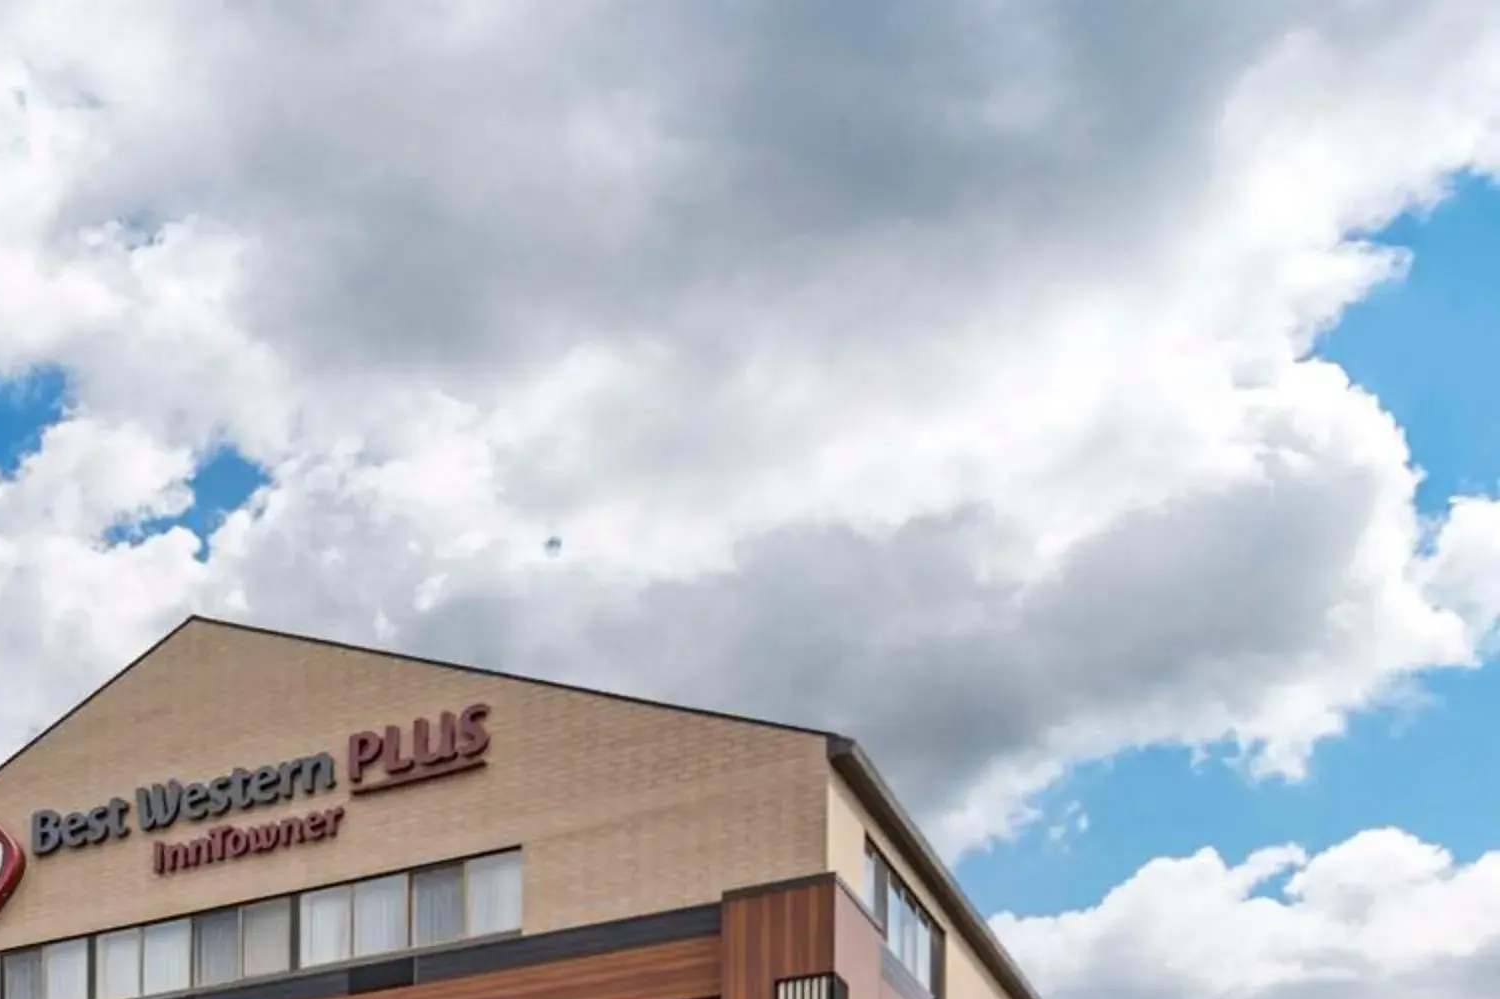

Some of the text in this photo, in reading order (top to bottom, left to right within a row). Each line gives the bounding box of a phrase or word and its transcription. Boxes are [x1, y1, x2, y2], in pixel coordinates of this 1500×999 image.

[30, 703, 492, 858] Best Western PLUS
[152, 804, 346, 876] InnTowner
